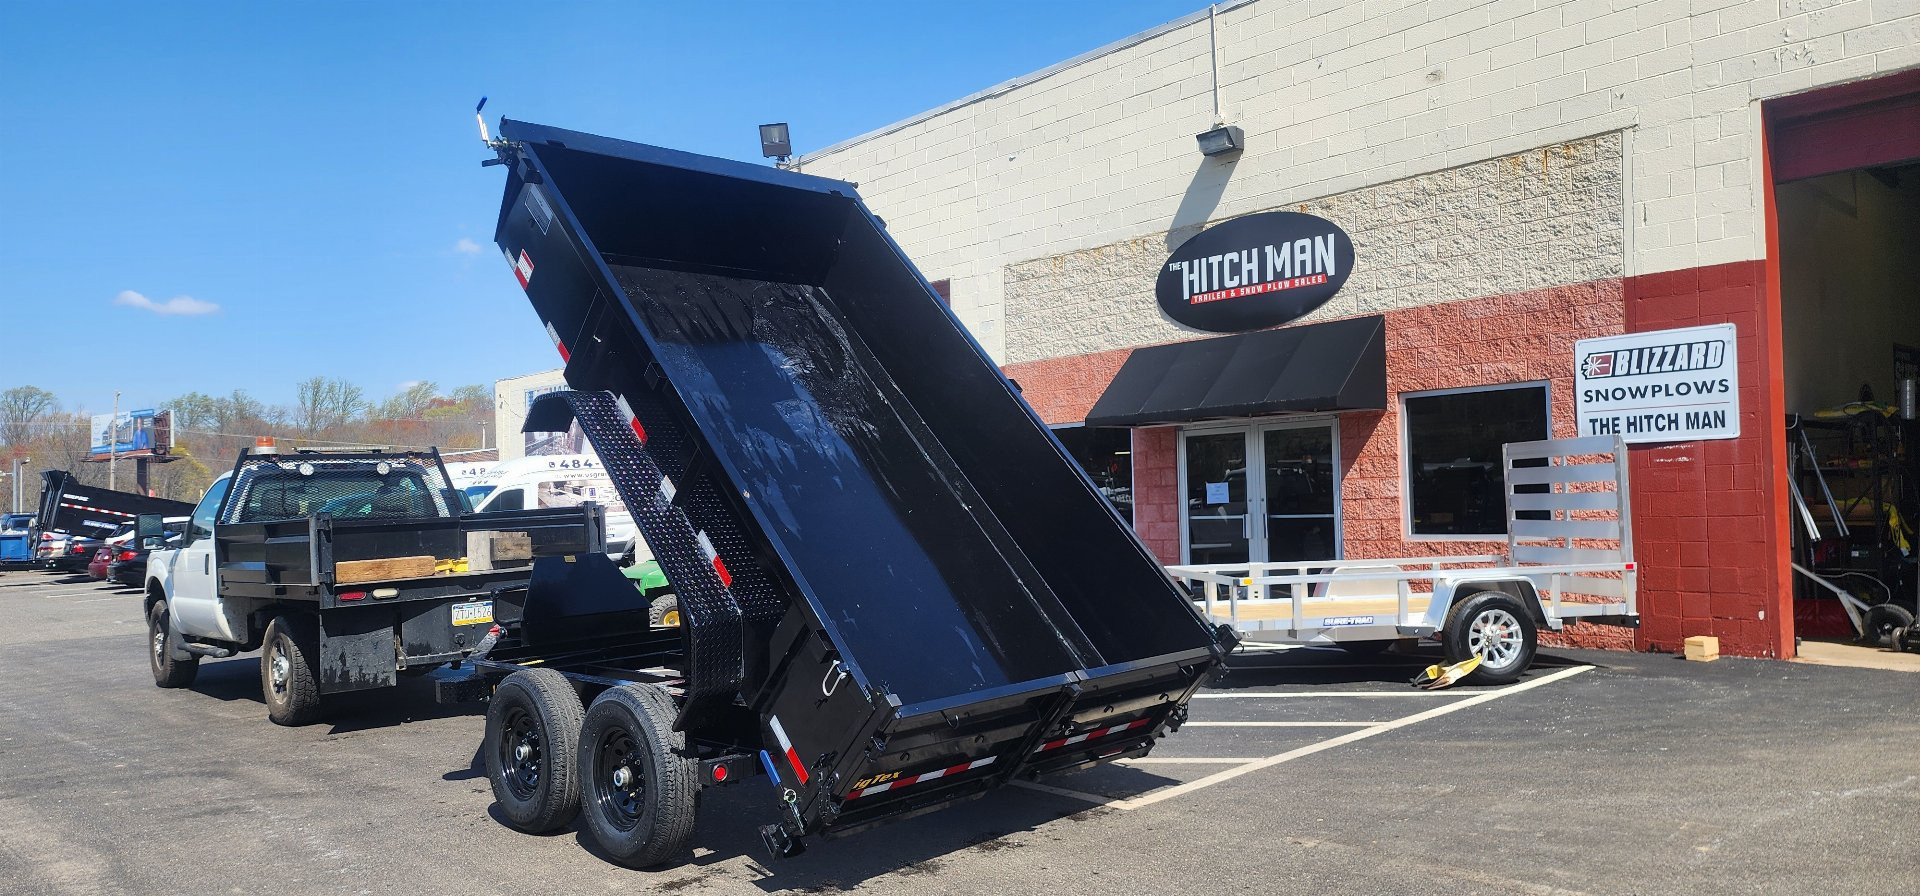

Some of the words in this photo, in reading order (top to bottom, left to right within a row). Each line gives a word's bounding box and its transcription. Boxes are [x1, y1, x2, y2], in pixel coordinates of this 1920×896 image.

[1169, 261, 1181, 271] THE
[1182, 247, 1259, 300] HITCH
[1264, 233, 1335, 281] MAN
[1194, 291, 1226, 303] TRAILER
[1230, 289, 1236, 297] &
[1240, 284, 1263, 296] SNOW
[1267, 280, 1291, 292] PLOW
[1294, 274, 1323, 287] SALES
[1614, 341, 1723, 377] BLIZZARD
[1583, 378, 1730, 403] SNOWPLOWS
[1589, 416, 1621, 436] THE
[1626, 412, 1679, 434] HITCH
[1685, 409, 1726, 431] MAN
